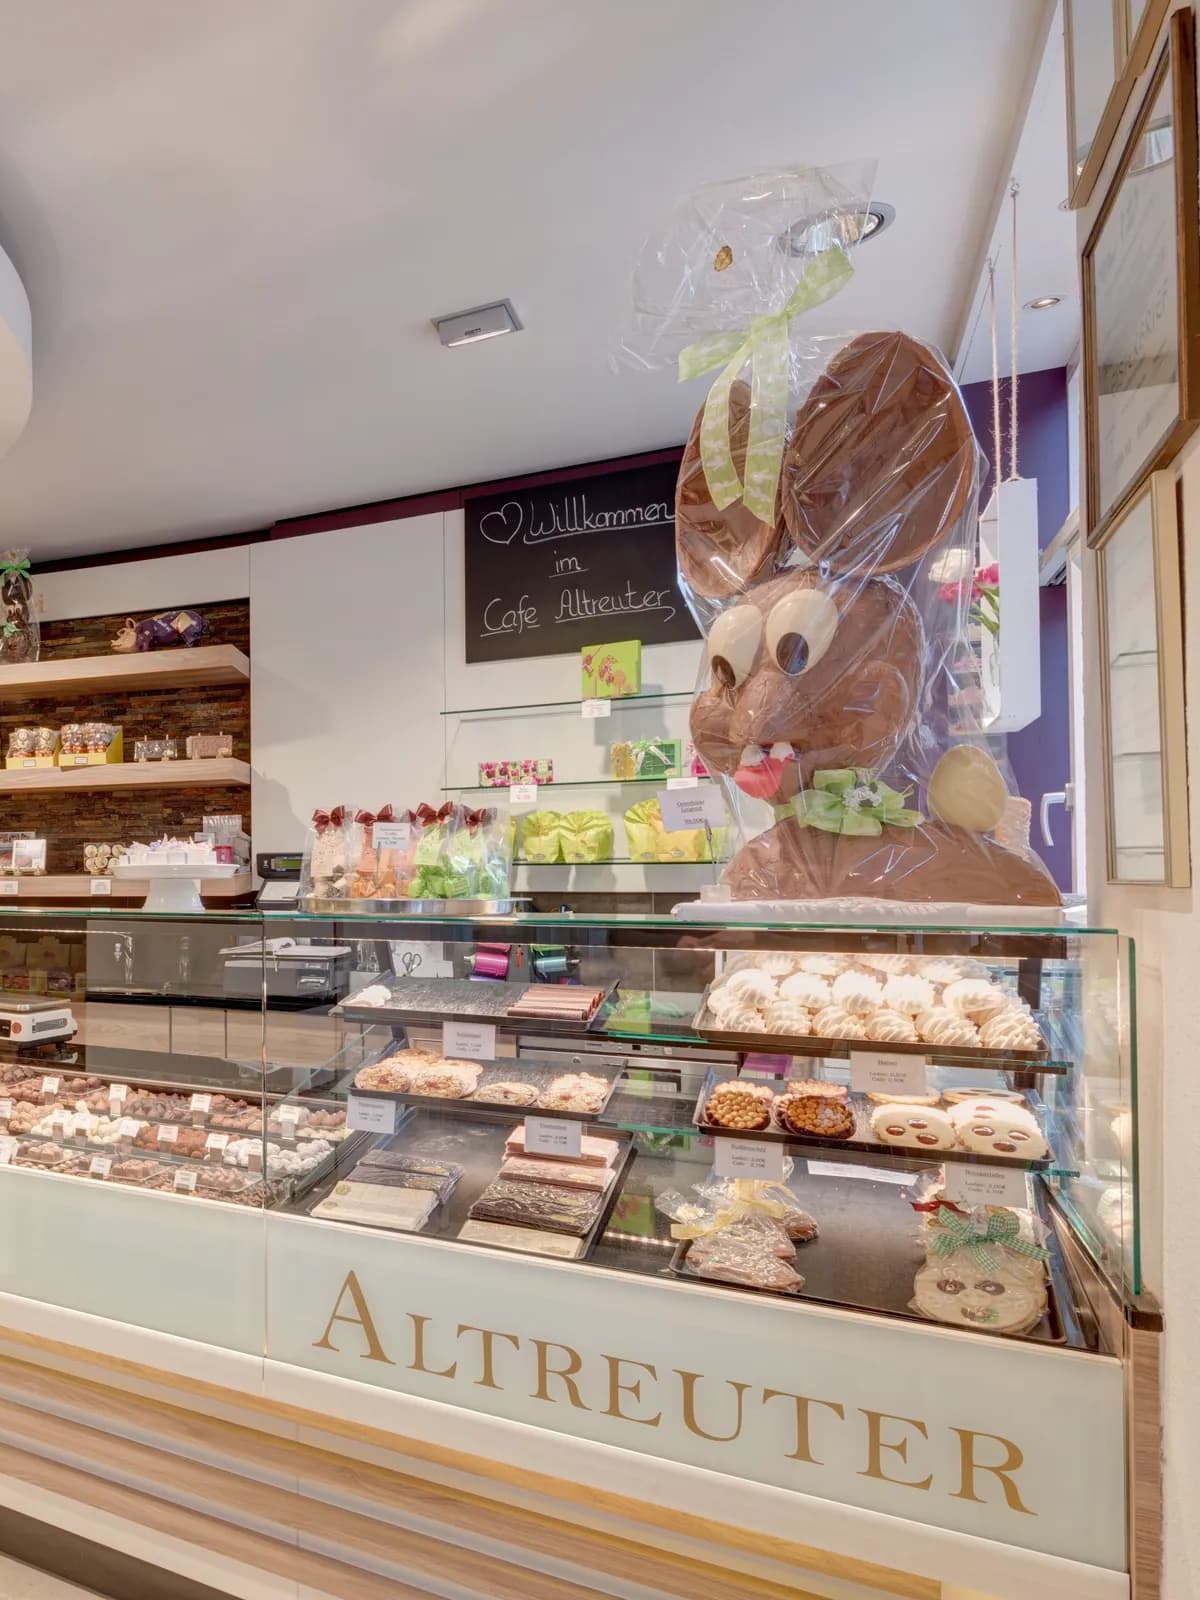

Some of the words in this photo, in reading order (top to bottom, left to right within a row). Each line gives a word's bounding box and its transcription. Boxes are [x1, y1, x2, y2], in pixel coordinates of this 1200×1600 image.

[529, 493, 676, 537] Willkommen
[554, 549, 582, 574] im
[483, 594, 538, 635] Cafe
[554, 579, 671, 621] Altreuter
[311, 1269, 1040, 1517] ALTREUTER
